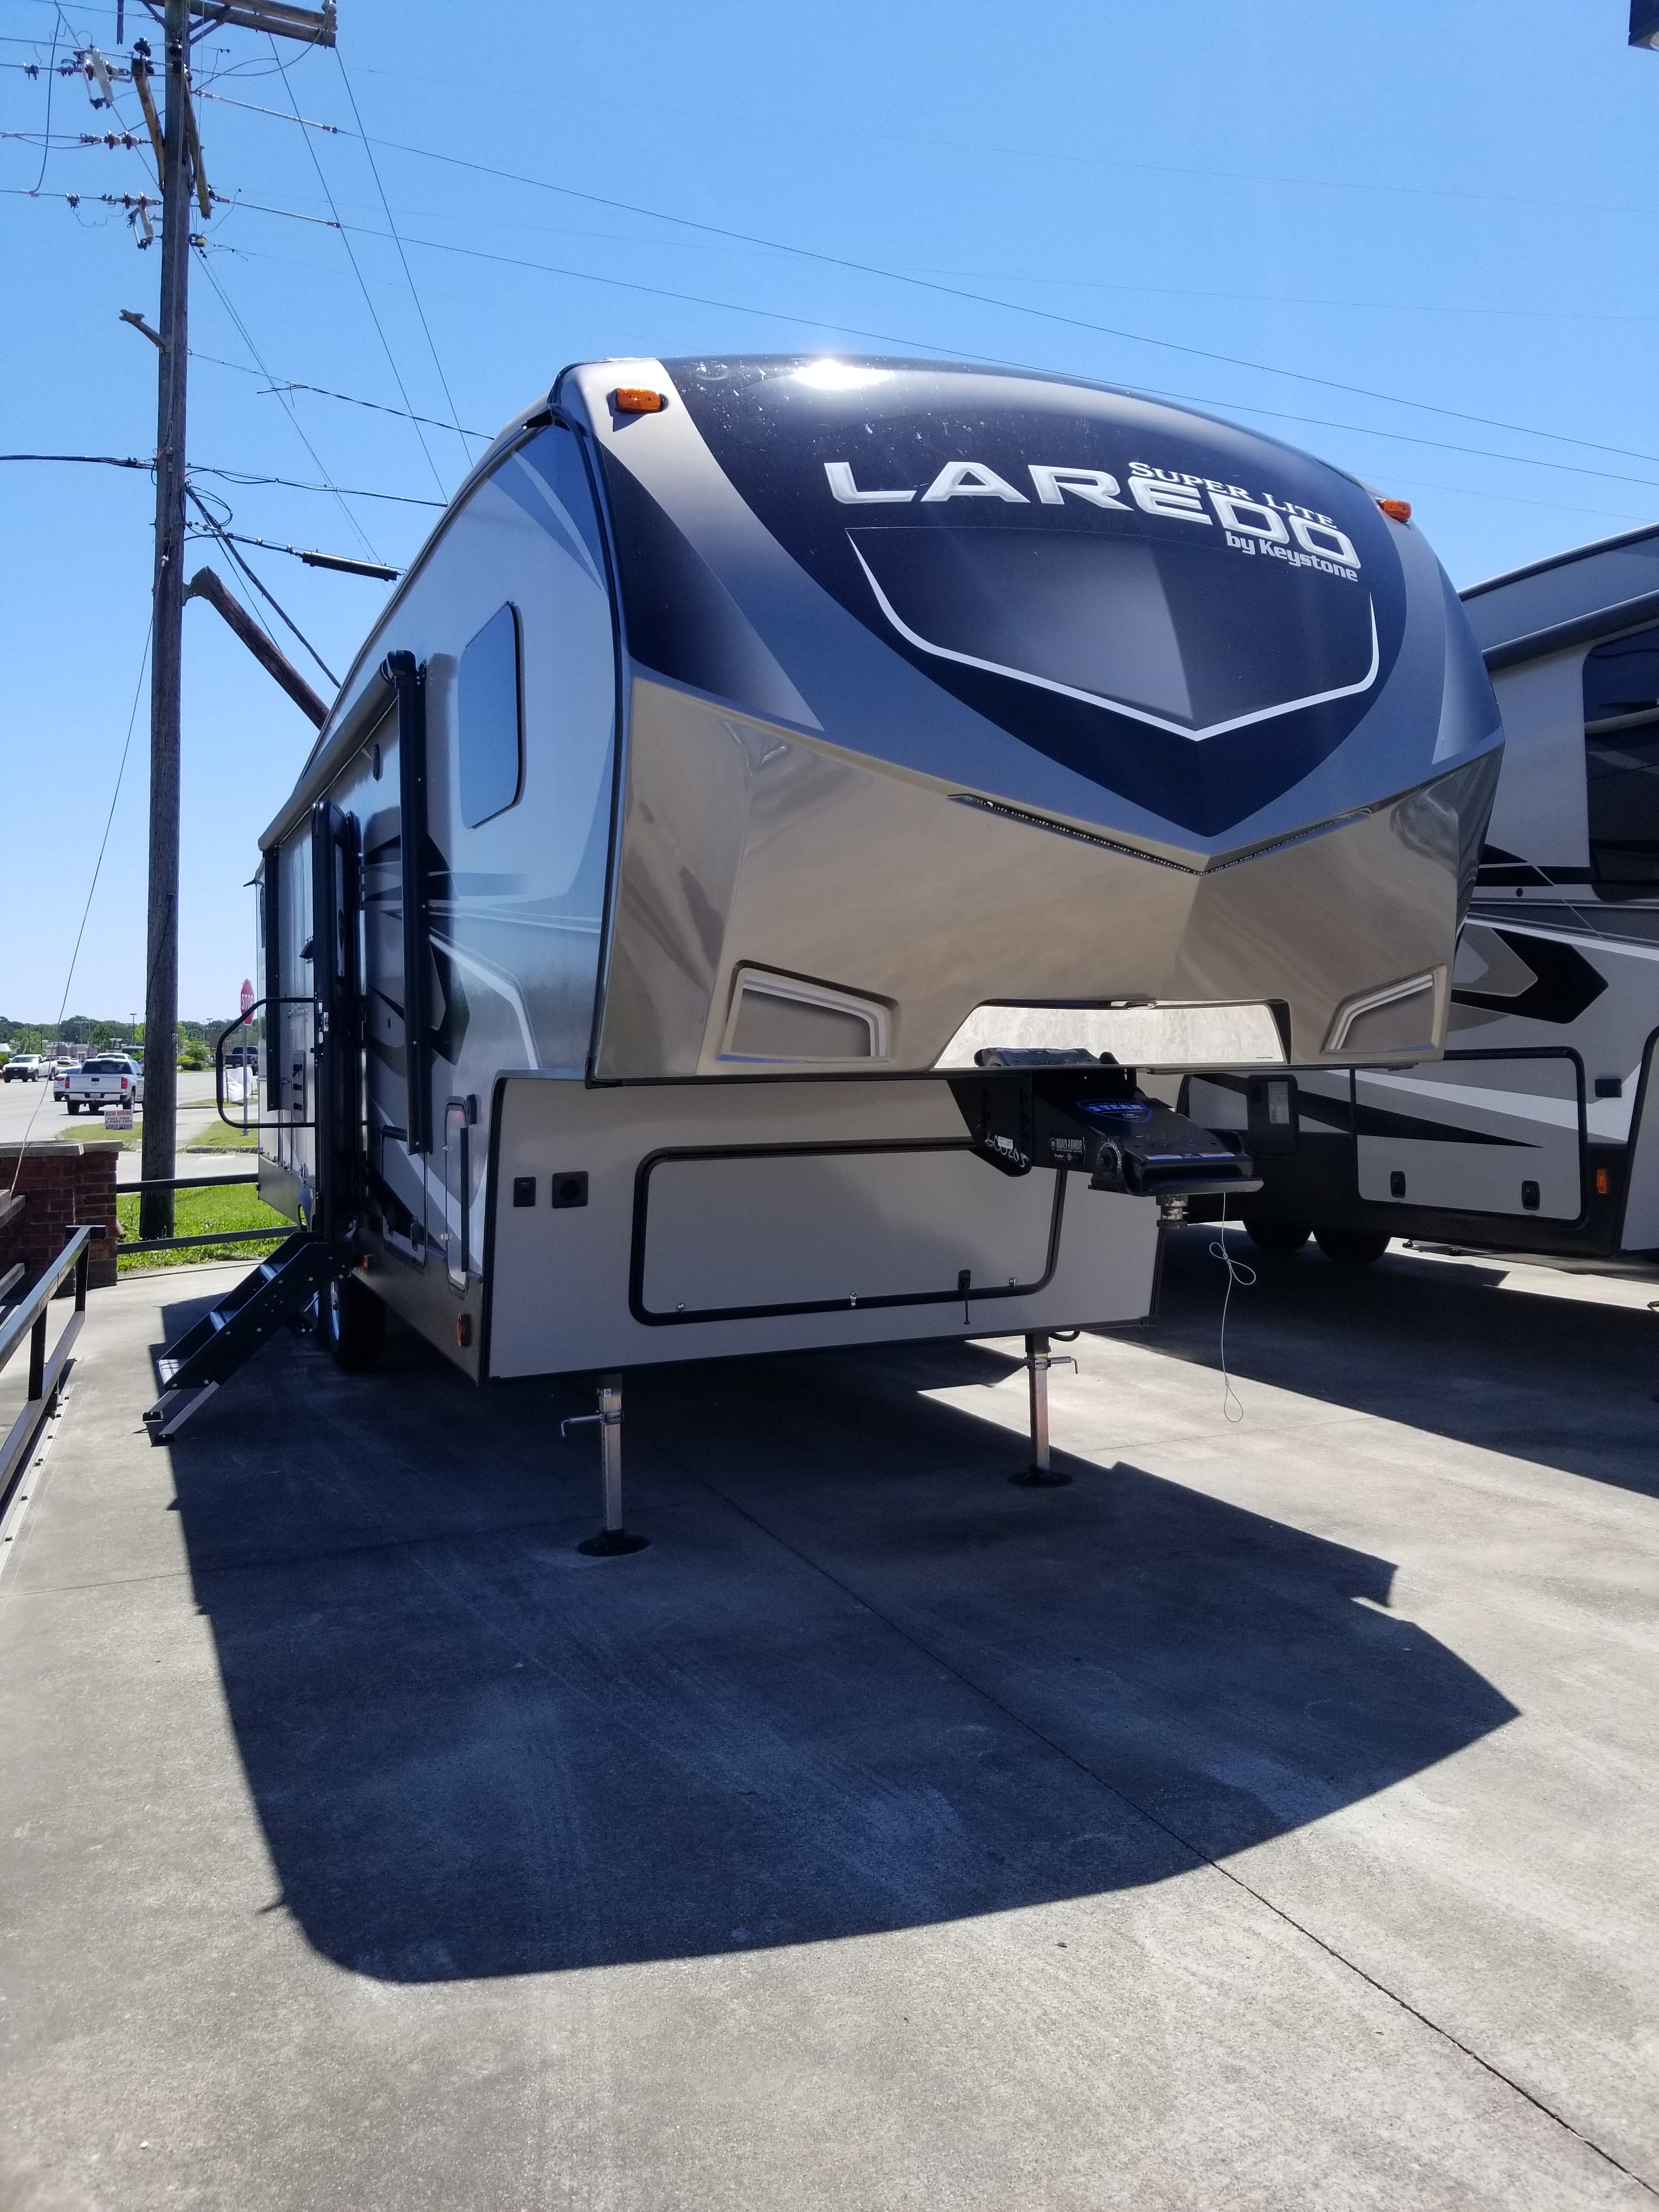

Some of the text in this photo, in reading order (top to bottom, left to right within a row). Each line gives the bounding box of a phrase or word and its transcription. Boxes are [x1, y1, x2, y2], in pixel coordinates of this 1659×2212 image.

[823, 461, 1361, 569] LAREDO
[1128, 461, 1338, 529] SUPER LITE
[1224, 531, 1359, 582] by Keystone
[241, 993, 254, 1011] STOP
[1056, 1138, 1082, 1150] ROAD ARMOR
